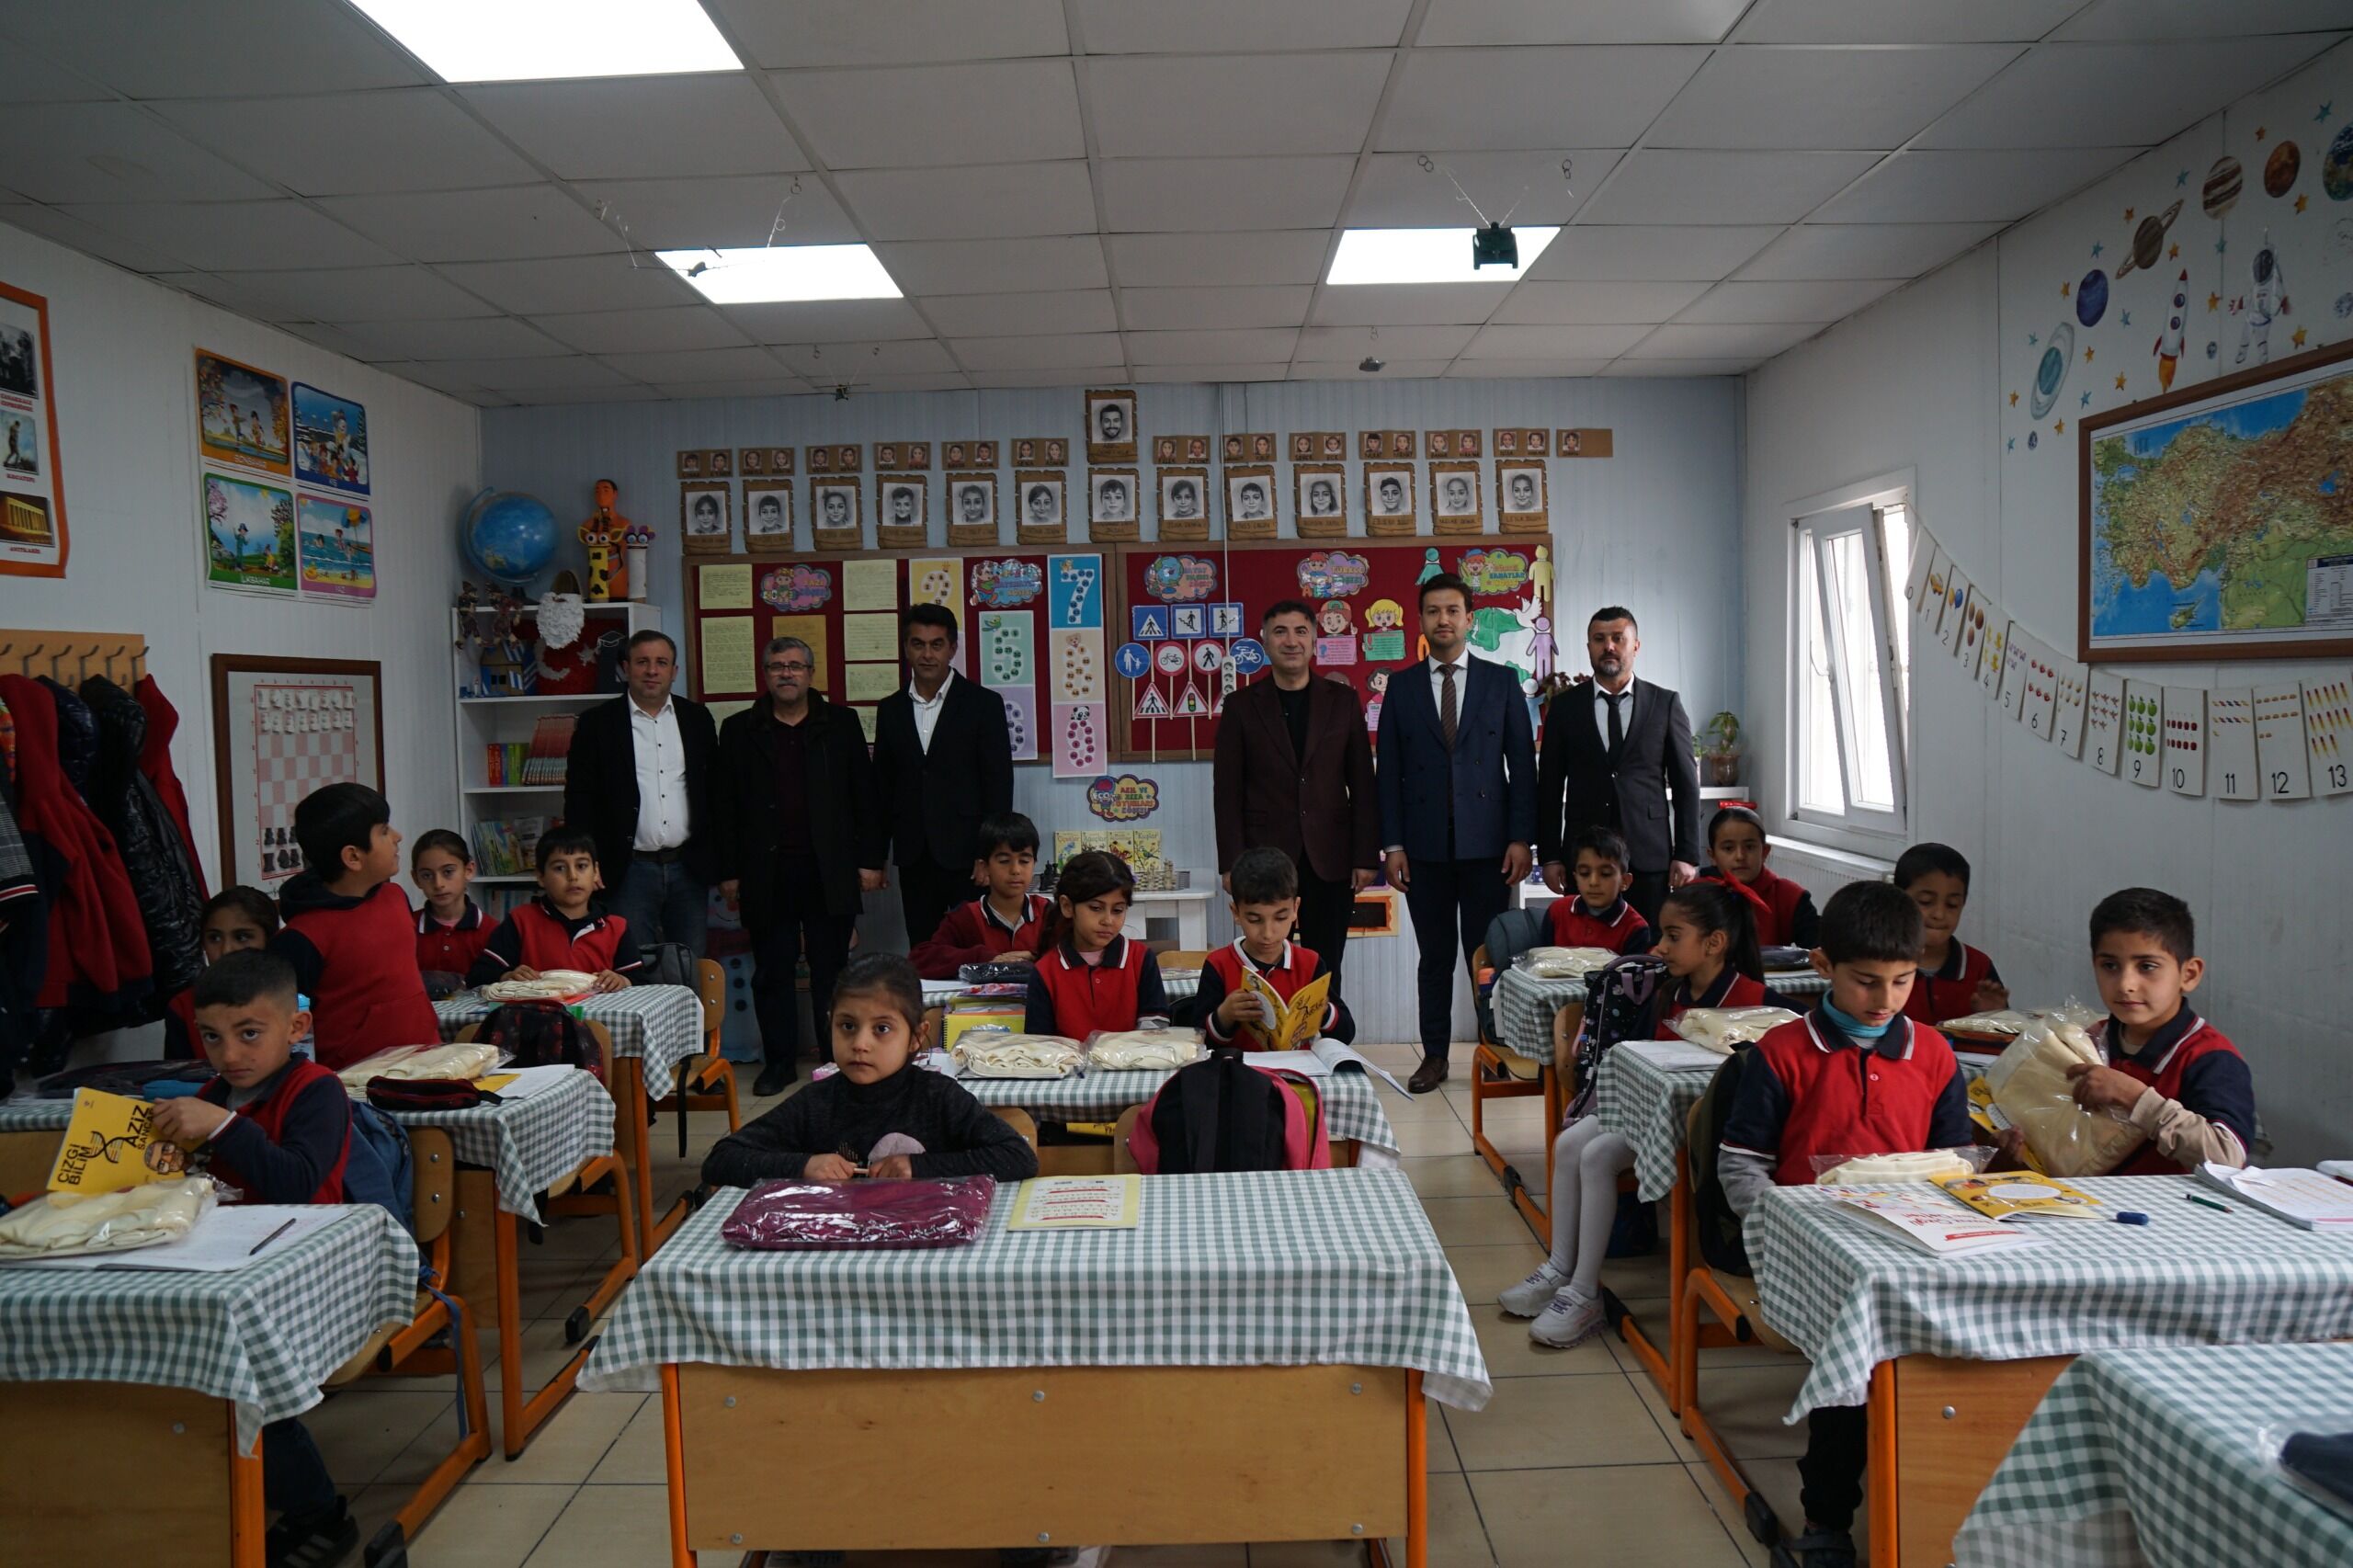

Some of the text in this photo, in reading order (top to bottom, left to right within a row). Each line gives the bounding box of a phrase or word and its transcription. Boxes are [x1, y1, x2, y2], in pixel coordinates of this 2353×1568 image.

[1060, 568, 1095, 624] 7
[1925, 608, 1930, 622] 1
[1941, 630, 1949, 646] 2
[992, 627, 1024, 682] 5
[1963, 653, 1970, 667] 3
[1984, 674, 1990, 688] 4
[2004, 691, 2011, 708] 5
[2031, 712, 2039, 730] 6
[2060, 729, 2068, 746] 7
[2097, 747, 2104, 766] 8
[2133, 759, 2142, 778] 9
[2172, 767, 2185, 789] 10
[2327, 764, 2347, 789] 13
[2225, 773, 2236, 794] 11
[2271, 771, 2290, 794] 12
